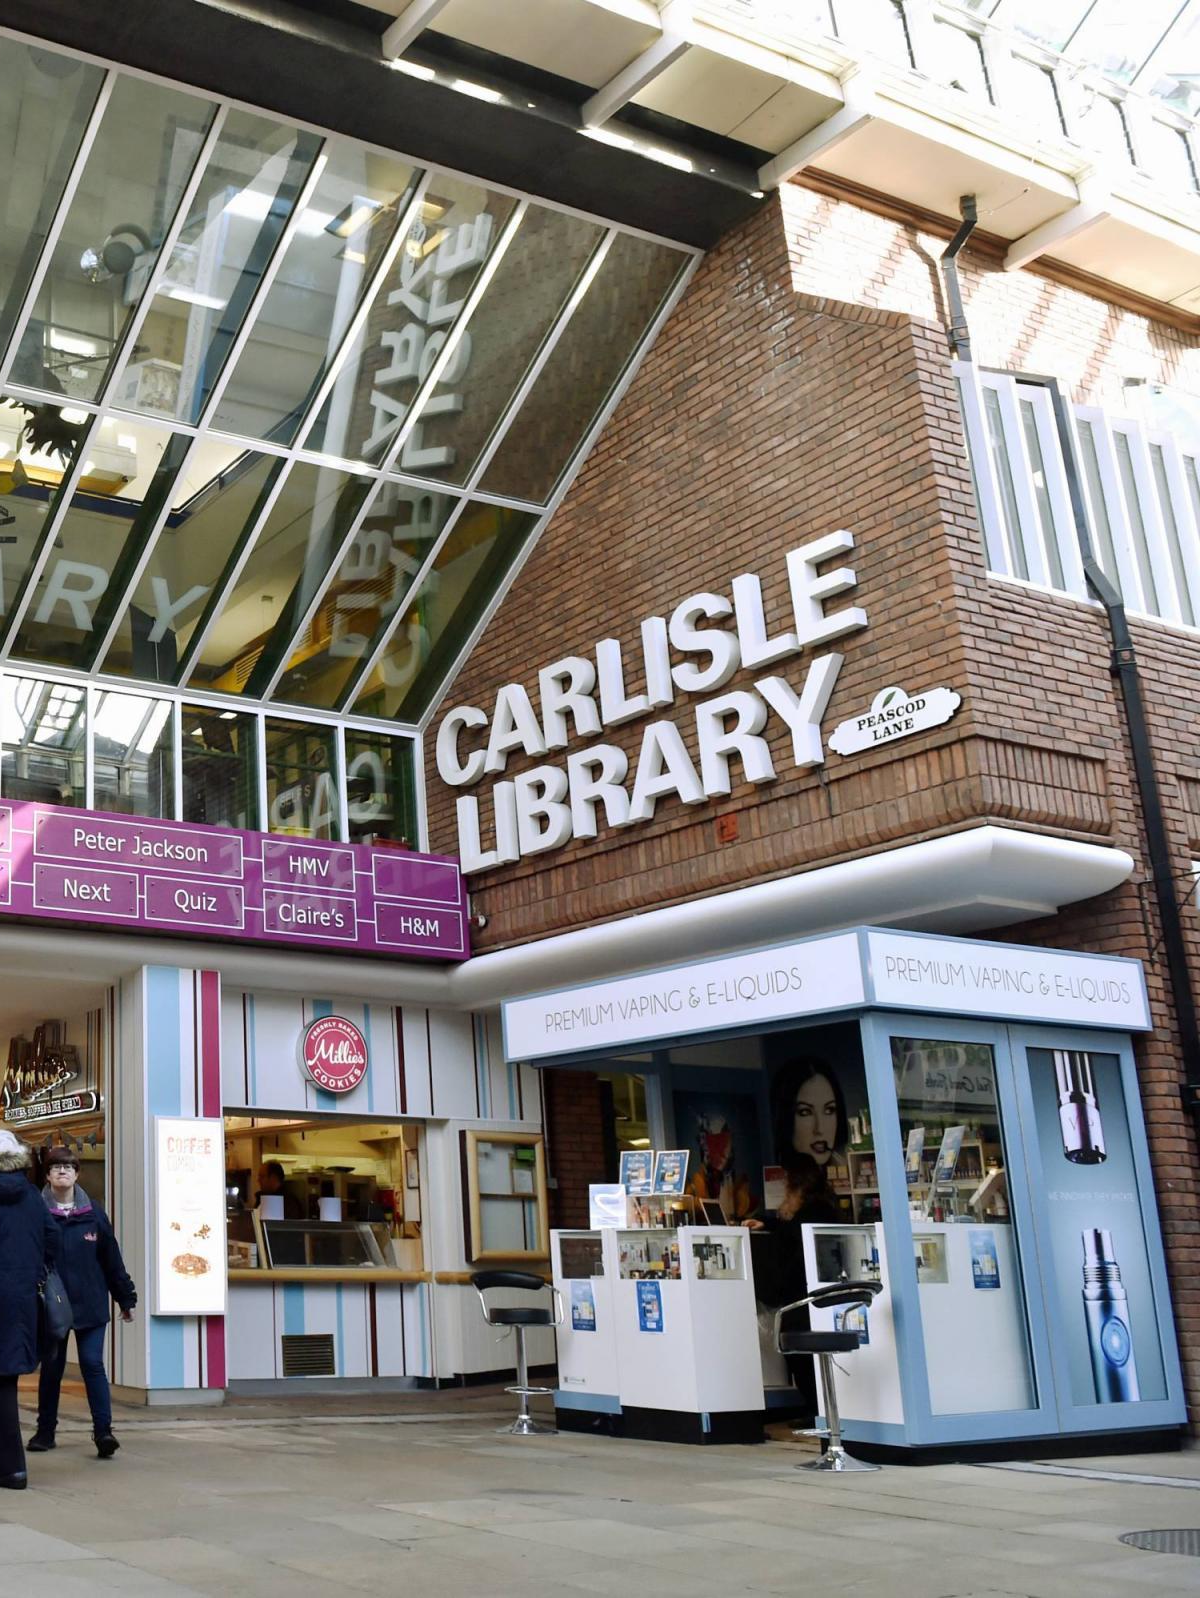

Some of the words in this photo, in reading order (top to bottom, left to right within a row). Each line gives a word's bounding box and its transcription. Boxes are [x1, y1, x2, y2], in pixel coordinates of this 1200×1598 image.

[436, 529, 868, 786] CARLISLE
[857, 698, 926, 731] PEASCOD
[873, 717, 914, 741] LANE
[456, 652, 845, 875] LIBRARY
[73, 829, 125, 853] Peter
[132, 834, 208, 863] Jackson
[289, 856, 330, 877] HMV
[63, 877, 111, 902] Next
[174, 888, 217, 913] Quiz
[278, 903, 344, 927] Claire's
[400, 916, 440, 938] H&M
[885, 956, 965, 987] PREMIUM
[969, 965, 1033, 994] VAPING
[1039, 973, 1050, 995] &
[1055, 975, 1131, 1004] E-LIQUIDS
[545, 1001, 614, 1033] PREMIUM
[617, 989, 682, 1021] VAPING
[688, 987, 701, 1008] &
[707, 967, 802, 1006] E-LIQUIDS
[307, 1039, 364, 1066] Millie's
[313, 1068, 361, 1089] COOKIES
